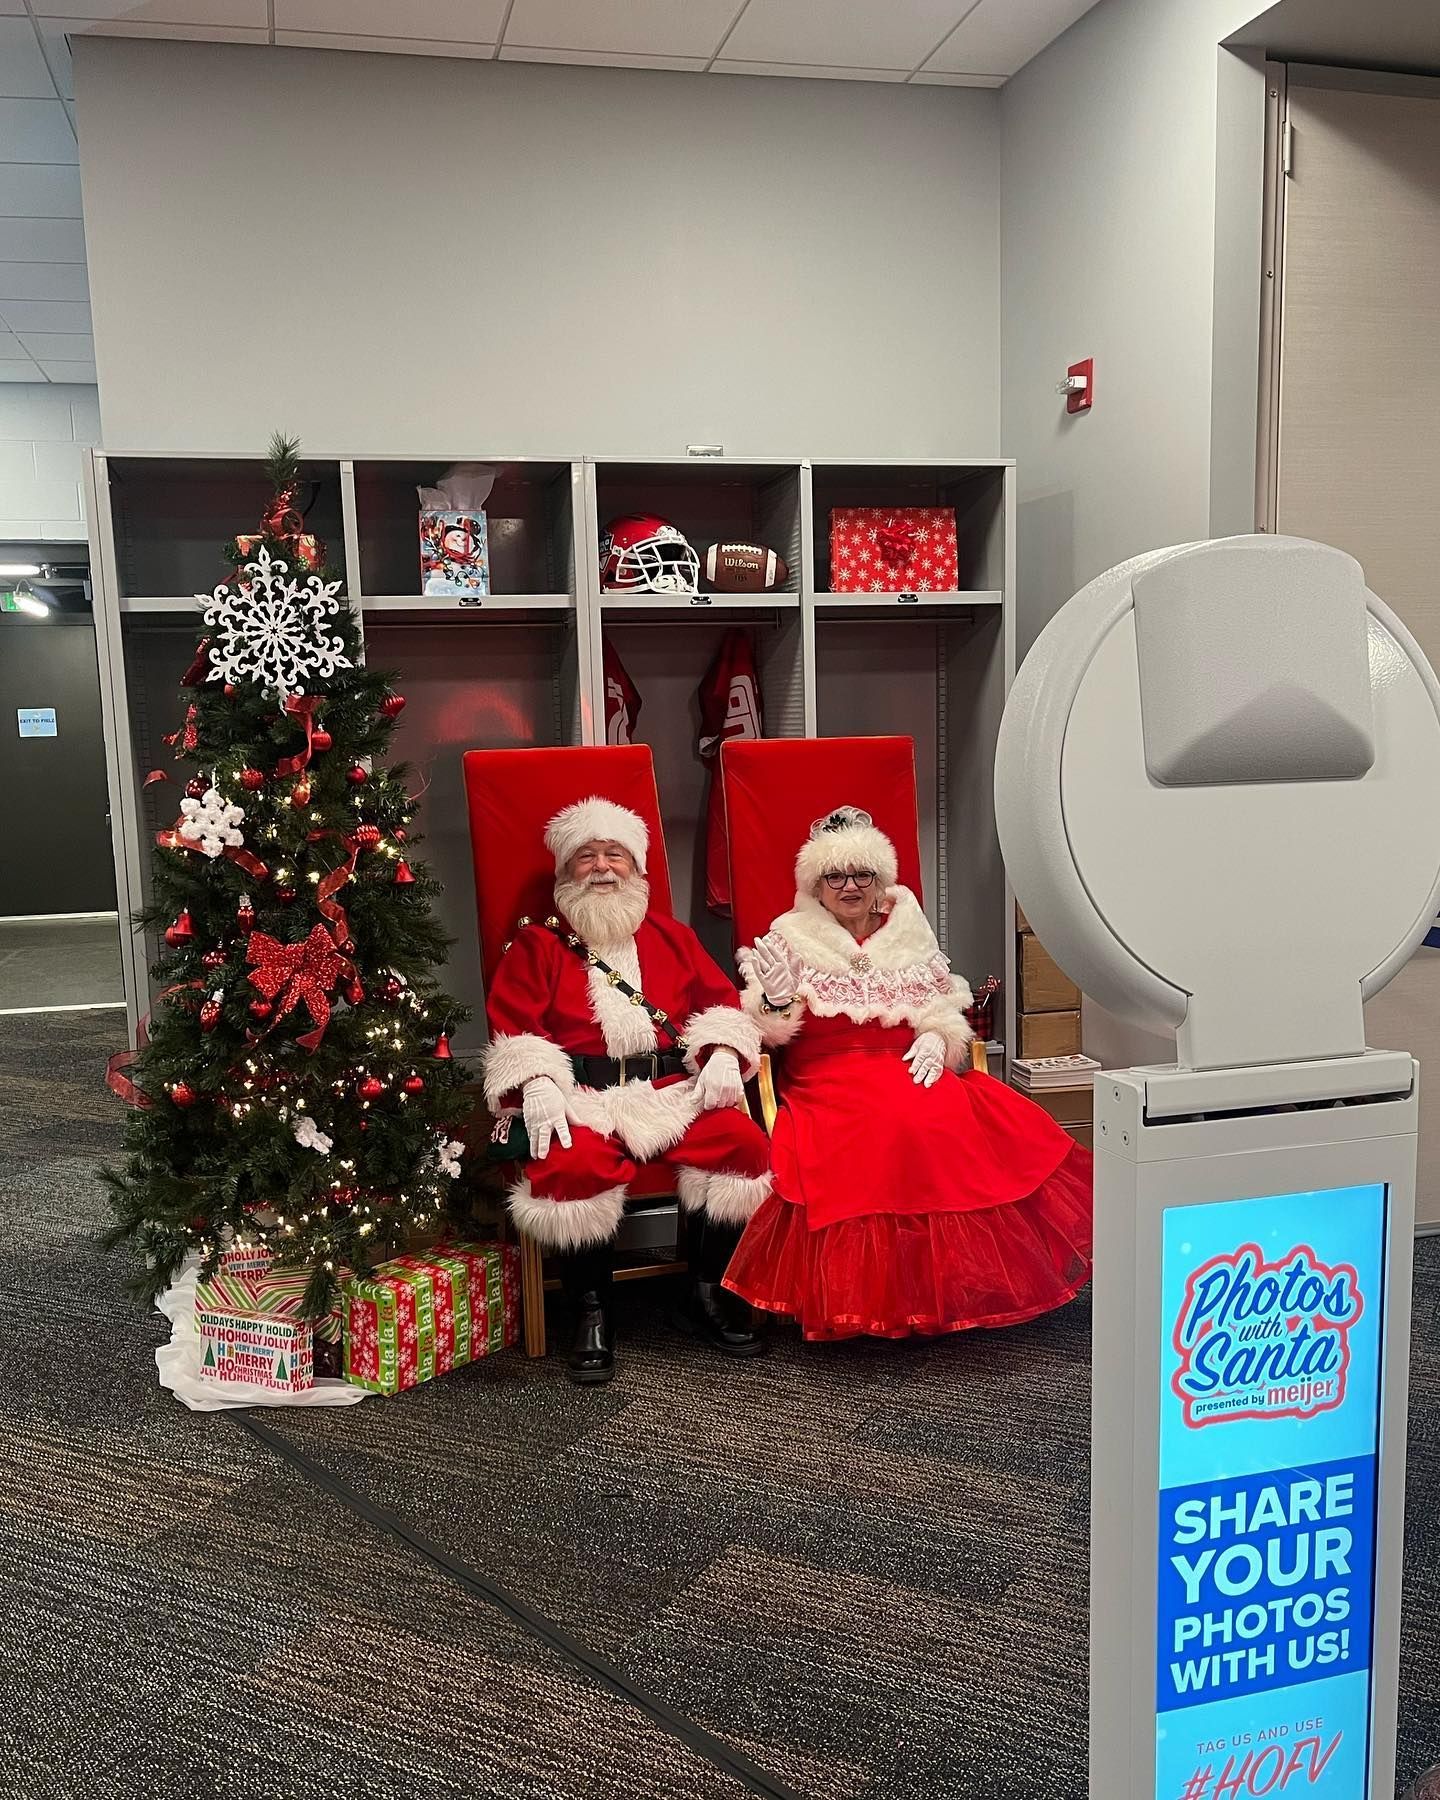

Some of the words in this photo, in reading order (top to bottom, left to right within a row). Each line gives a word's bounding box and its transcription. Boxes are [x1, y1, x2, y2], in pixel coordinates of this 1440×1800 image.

[724, 557, 759, 570] Wilson
[228, 1251, 255, 1262] HOLLY
[228, 1263, 244, 1271] VERY
[1186, 1257, 1352, 1342] Photos
[200, 1325, 216, 1337] LLY
[235, 1332, 263, 1345] HOLLY
[263, 1337, 289, 1350] JOLLY
[235, 1320, 263, 1333] HAPPY
[1238, 1312, 1284, 1342] with
[234, 1343, 250, 1353] VERY
[252, 1346, 275, 1357] MERRY
[235, 1352, 274, 1370] MERRY
[1184, 1324, 1338, 1392] Santa
[218, 1357, 235, 1372] HO
[234, 1366, 273, 1380] CHRISTMAS
[1196, 1395, 1249, 1414] presented
[1251, 1394, 1265, 1406] by
[1267, 1377, 1334, 1406] meijer
[1173, 1473, 1354, 1545] SHARE
[1170, 1526, 1353, 1604] YOUR
[1174, 1587, 1350, 1653] PHOTOS
[1170, 1644, 1275, 1694] WITH
[1288, 1629, 1350, 1670] US!
[1196, 1739, 1226, 1754] TAG
[1232, 1733, 1252, 1746] US
[1257, 1725, 1289, 1742] AND
[1295, 1717, 1323, 1733] USE
[1176, 1729, 1344, 1800] #HOFV
